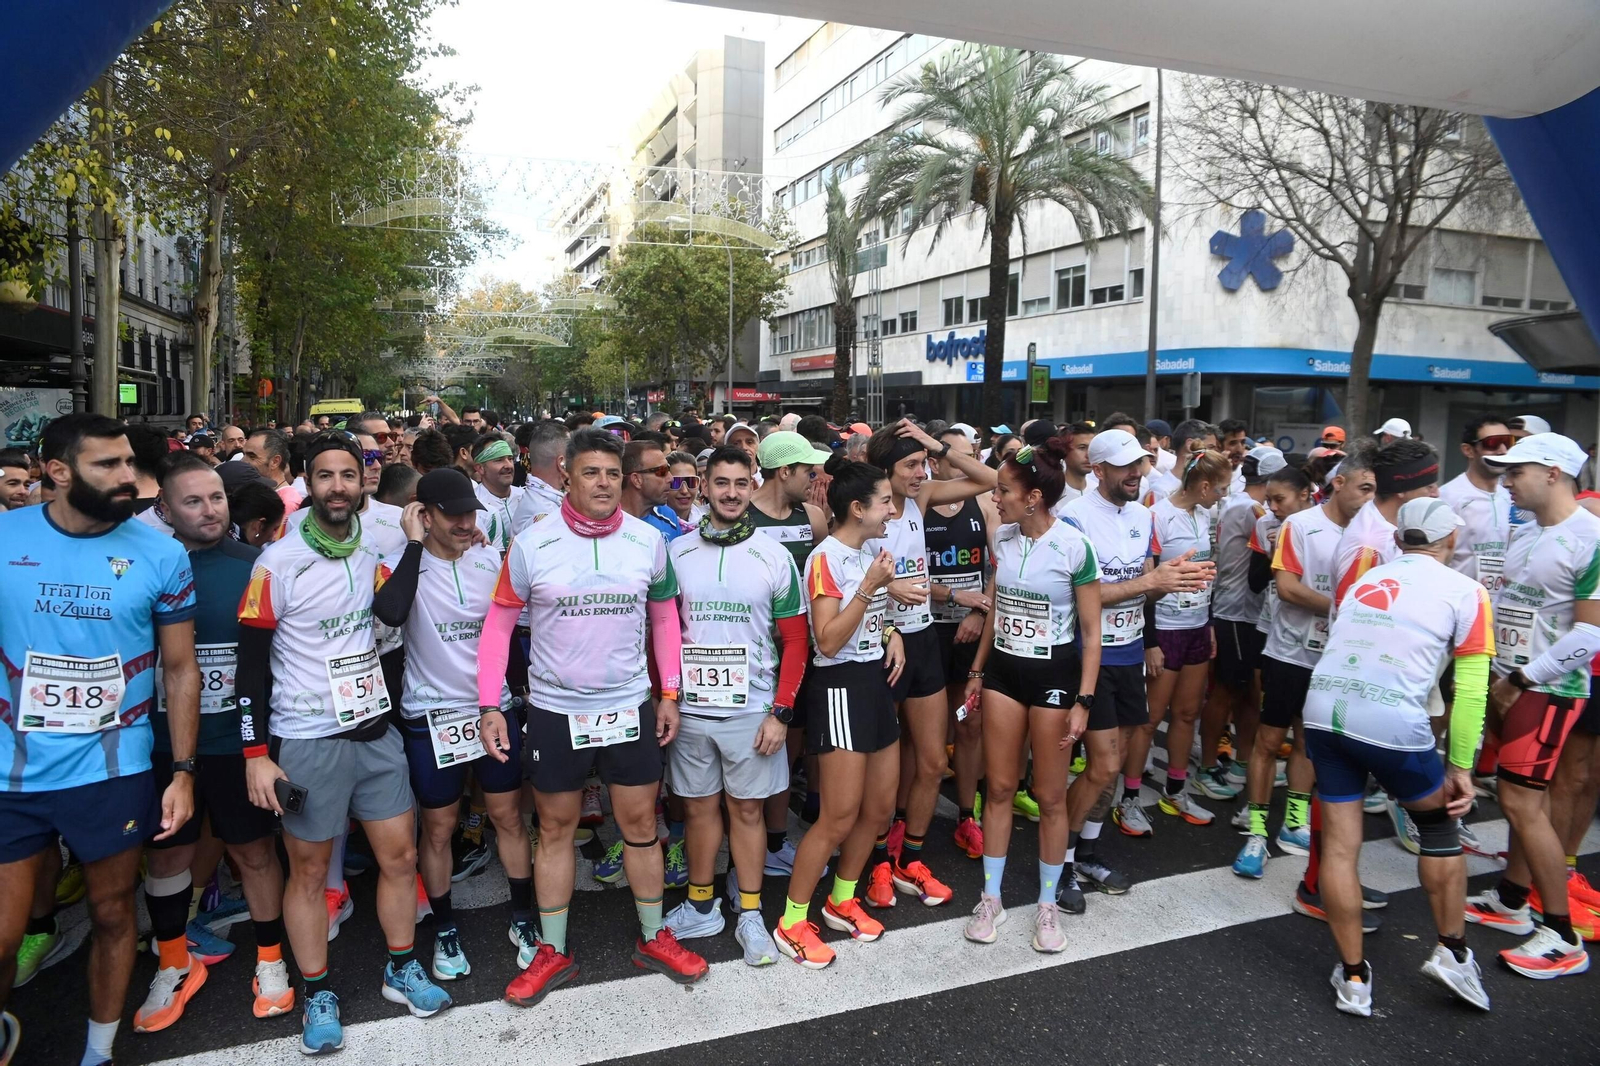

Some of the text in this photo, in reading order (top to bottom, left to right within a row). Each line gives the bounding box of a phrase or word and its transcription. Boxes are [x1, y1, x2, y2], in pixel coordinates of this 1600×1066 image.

[1065, 364, 1093, 375] Sabadell
[1156, 358, 1194, 370] Sabadell
[1314, 359, 1350, 373] Sabade
[1433, 367, 1471, 379] Sabadell
[1541, 372, 1575, 384] Sabadell
[736, 391, 762, 399] VisionLab
[375, 518, 387, 526] SIG
[622, 532, 637, 542] SIG
[746, 548, 761, 559] SIG
[474, 562, 486, 570] SIG
[555, 593, 638, 607] XII SUBIDA
[1010, 588, 1051, 602] SUBIDA
[34, 599, 113, 620] MeZquita
[561, 606, 635, 616] A LAS ERMITAS
[688, 601, 752, 613] XII SUBIDA
[318, 617, 340, 630] XII
[696, 614, 711, 622] LAS
[713, 614, 750, 623] ERMITAS
[1003, 616, 1036, 638] 655
[323, 632, 330, 640] A
[333, 627, 351, 638] LAS
[42, 659, 68, 668] SUBIDA
[75, 662, 89, 670] LAS
[89, 659, 117, 670] ERMITAS
[696, 668, 733, 687] 131
[355, 674, 374, 698] 57
[43, 684, 103, 708] 518
